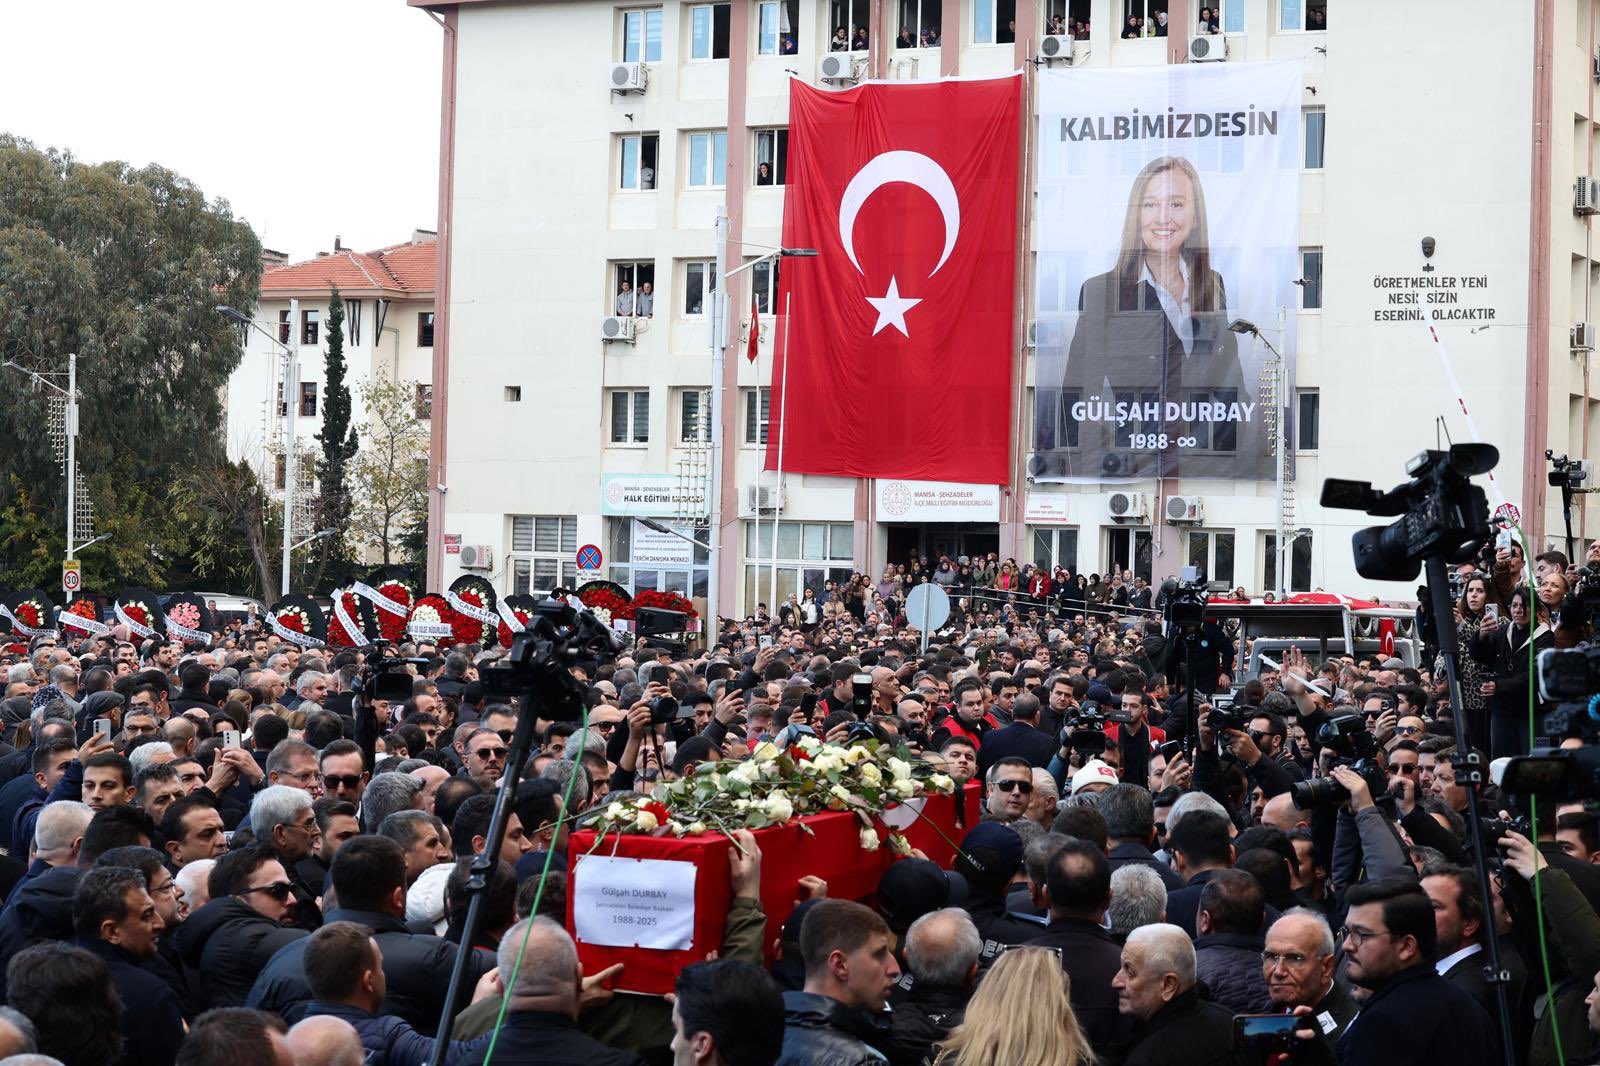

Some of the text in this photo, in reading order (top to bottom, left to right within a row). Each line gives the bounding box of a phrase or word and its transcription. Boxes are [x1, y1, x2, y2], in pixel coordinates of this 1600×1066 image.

[1060, 104, 1278, 142] KALBİMİZDESİN
[1461, 274, 1488, 288] YENİ
[1426, 290, 1458, 304] SİZİN
[1431, 308, 1496, 320] OLACAKTIR
[1071, 395, 1256, 428] GÜLŞAH DURBAY
[623, 495, 643, 503] HALK
[66, 575, 76, 585] 30
[601, 887, 668, 899] Gülşah DURBAY
[612, 915, 658, 926] 1988-2025
